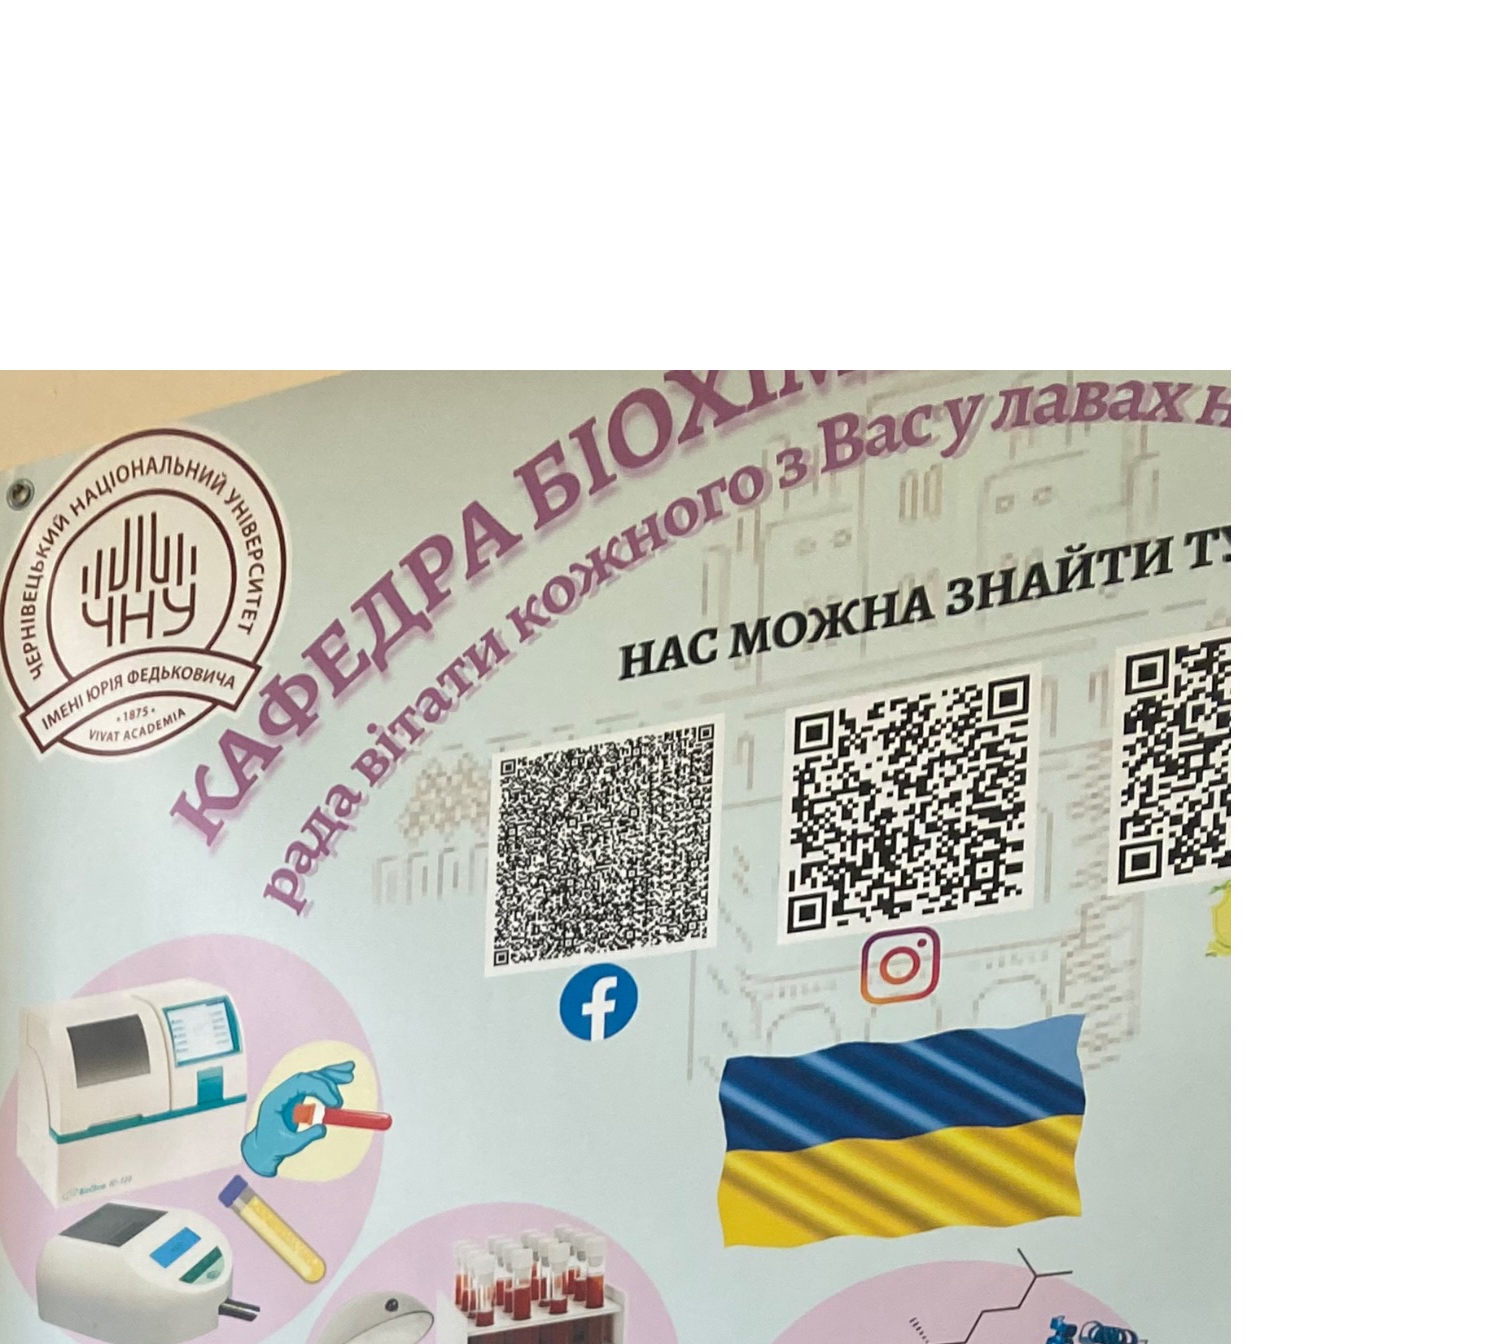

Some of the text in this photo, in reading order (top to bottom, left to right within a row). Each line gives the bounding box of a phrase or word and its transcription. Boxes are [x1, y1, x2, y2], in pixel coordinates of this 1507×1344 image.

[21, 455, 265, 680] ЧЕРНІВЕЦЬКИЙ НАЦІОНАЛЬНИЙ УНІВЕРСИТЕТ
[82, 580, 197, 648] ЧНУ
[618, 628, 718, 681] НАС
[728, 584, 935, 659] МОЖНА
[946, 536, 1174, 616] ЗНАЙТИ
[41, 665, 236, 730] ІМЕНІ ЮРІЯ ФЕДЬКОВИЧА
[169, 500, 523, 848] КАФЕДРА
[263, 776, 362, 916] рада
[350, 627, 510, 787] вітати
[505, 465, 764, 643] кожного
[776, 447, 808, 489] з
[817, 404, 932, 473] Вас
[940, 394, 985, 458] у
[991, 380, 1194, 431] лавах
[88, 707, 186, 743] VIVAT ACADEMIA
[122, 705, 149, 721] 1875
